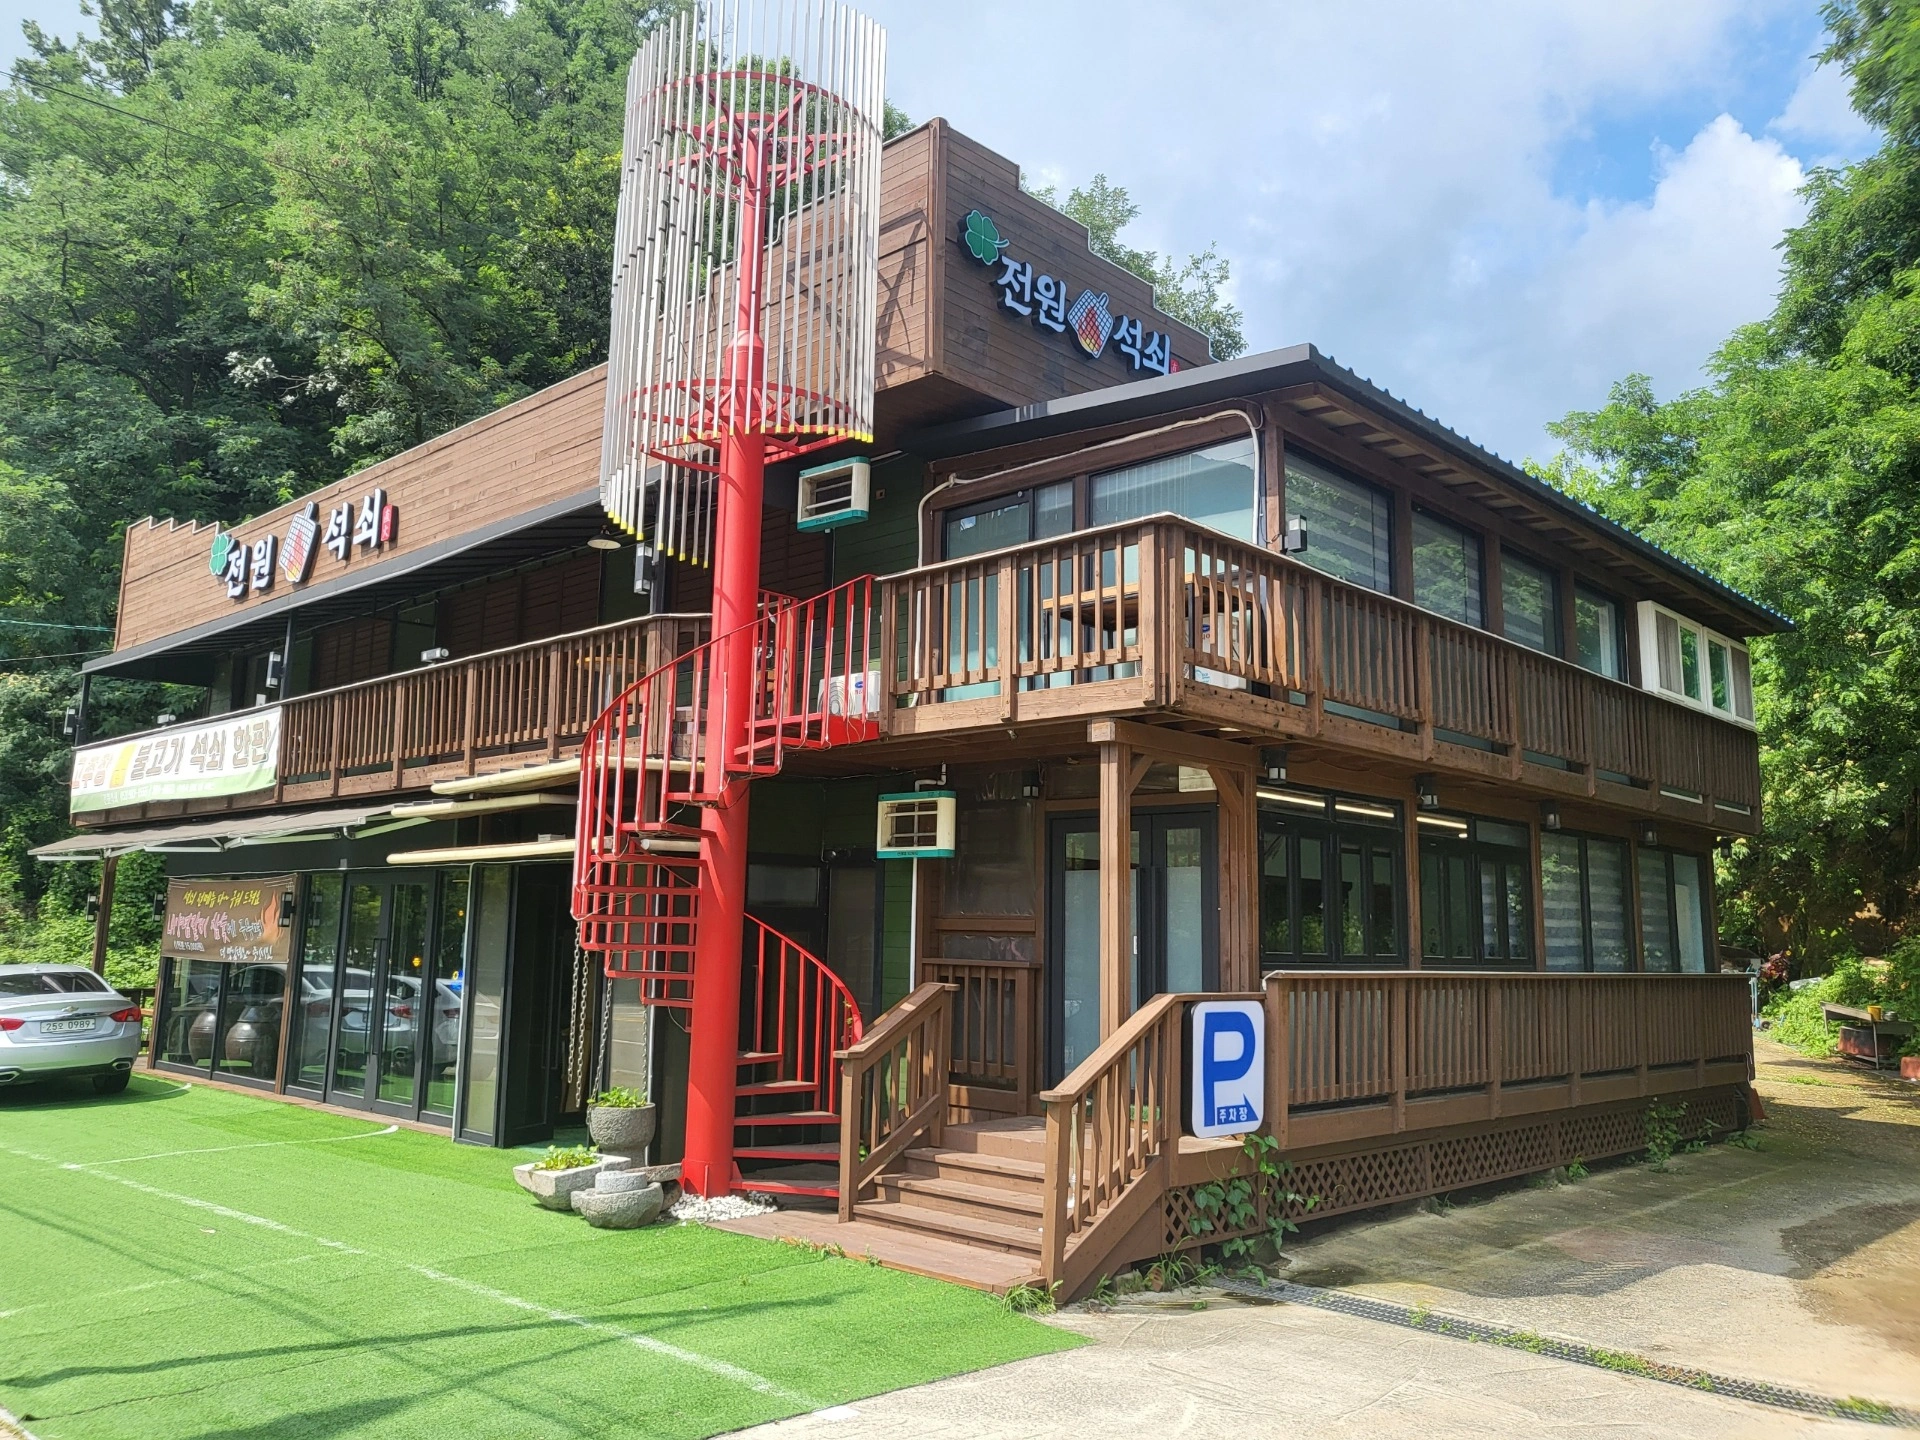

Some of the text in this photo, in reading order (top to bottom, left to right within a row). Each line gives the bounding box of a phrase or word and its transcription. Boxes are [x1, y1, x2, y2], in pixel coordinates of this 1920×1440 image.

[998, 255, 1171, 376] 전원 석쇠
[225, 488, 382, 598] 전원 석쇠
[190, 729, 226, 773] 석쇠
[233, 719, 271, 769] 한판
[67, 1020, 91, 1030] 0989
[1203, 1011, 1256, 1127] P
[1219, 1107, 1248, 1122] 주차장
